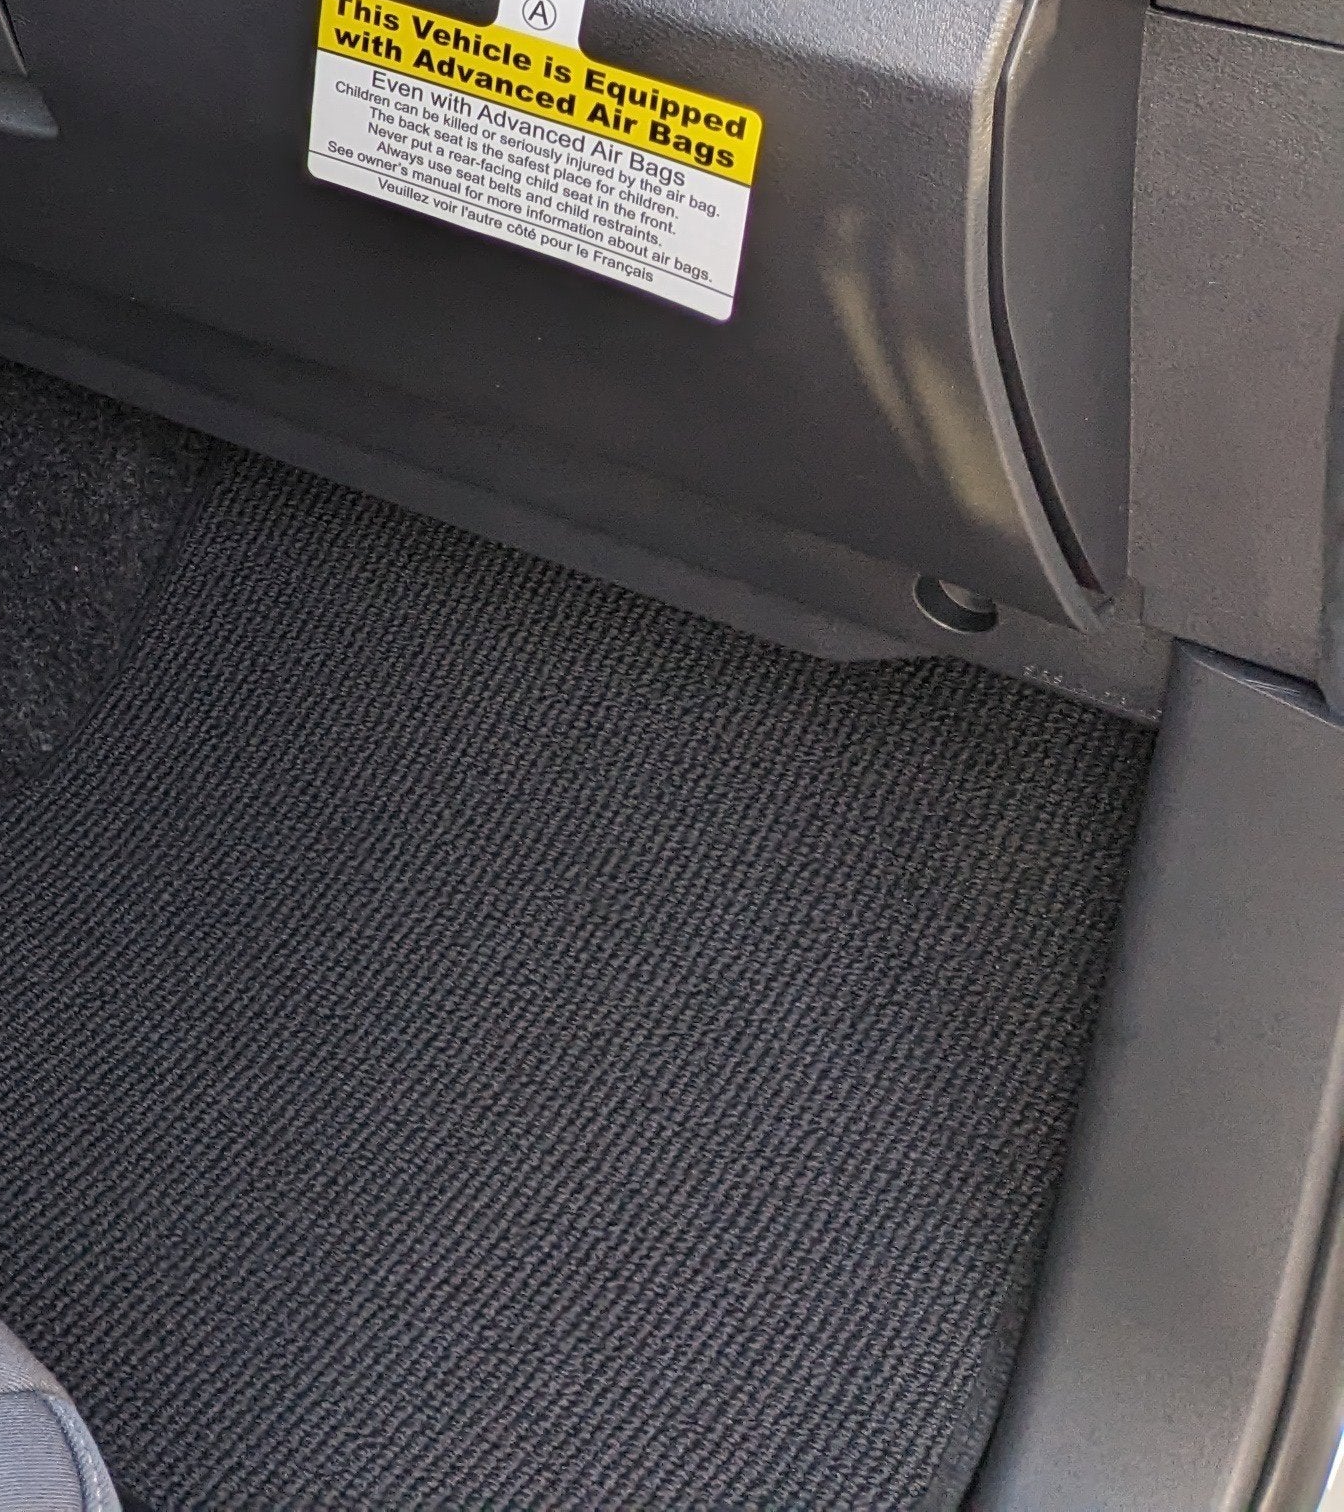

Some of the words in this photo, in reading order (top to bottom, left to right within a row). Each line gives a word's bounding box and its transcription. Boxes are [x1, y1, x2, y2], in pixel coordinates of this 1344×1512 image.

[528, 0, 548, 26] A
[334, 27, 402, 63] with
[413, 48, 576, 117] Advanced
[586, 101, 638, 135] Air
[648, 119, 735, 169] Bags
[372, 70, 423, 102] Even
[431, 91, 472, 117] with
[477, 104, 585, 153] Advanced
[590, 140, 623, 164] Air
[629, 151, 686, 187] Bags
[412, 15, 532, 71] Vehicle
[543, 56, 572, 84] is
[584, 68, 747, 141] Equipped
[335, 80, 390, 107] Children
[394, 101, 418, 116] can
[422, 107, 439, 123] be
[443, 114, 479, 135] killed
[482, 129, 496, 141] or
[500, 134, 562, 164] seriously
[566, 152, 614, 179] injured
[618, 170, 636, 188] by
[640, 178, 662, 196] the
[666, 189, 686, 204] air
[689, 195, 720, 218] bag.
[368, 122, 408, 144] Never
[411, 138, 433, 153] put
[436, 146, 445, 157] a
[449, 150, 522, 184] rear-facing
[526, 174, 559, 193] child
[563, 187, 593, 206] seat
[596, 196, 609, 211] in
[614, 202, 636, 220] the
[640, 211, 676, 235] front.
[370, 106, 395, 124] The
[398, 115, 430, 136] back
[434, 129, 463, 147] seat
[466, 137, 478, 151] is
[482, 143, 503, 160] the
[507, 153, 550, 175] safest
[553, 168, 592, 188] place
[596, 179, 615, 196] for
[619, 189, 679, 219] children.
[376, 141, 424, 166] Always
[428, 159, 452, 175] use
[456, 168, 485, 187] seat
[489, 177, 522, 198] belts
[525, 191, 552, 208] and
[556, 201, 589, 221] child
[593, 213, 663, 247] restraints.
[328, 140, 354, 158] See
[357, 151, 408, 176] owner's
[412, 169, 461, 194] manual
[465, 185, 484, 201] for
[487, 195, 522, 214] more
[526, 205, 604, 242] information
[607, 236, 649, 258] about
[652, 251, 671, 266] air
[674, 257, 713, 283] bags.
[378, 177, 430, 205] Veuillez
[433, 198, 458, 214] voir
[461, 205, 502, 229] l'autre
[507, 223, 537, 240] côté
[540, 234, 573, 252] pour
[576, 244, 589, 258] le
[593, 250, 654, 282] Français
